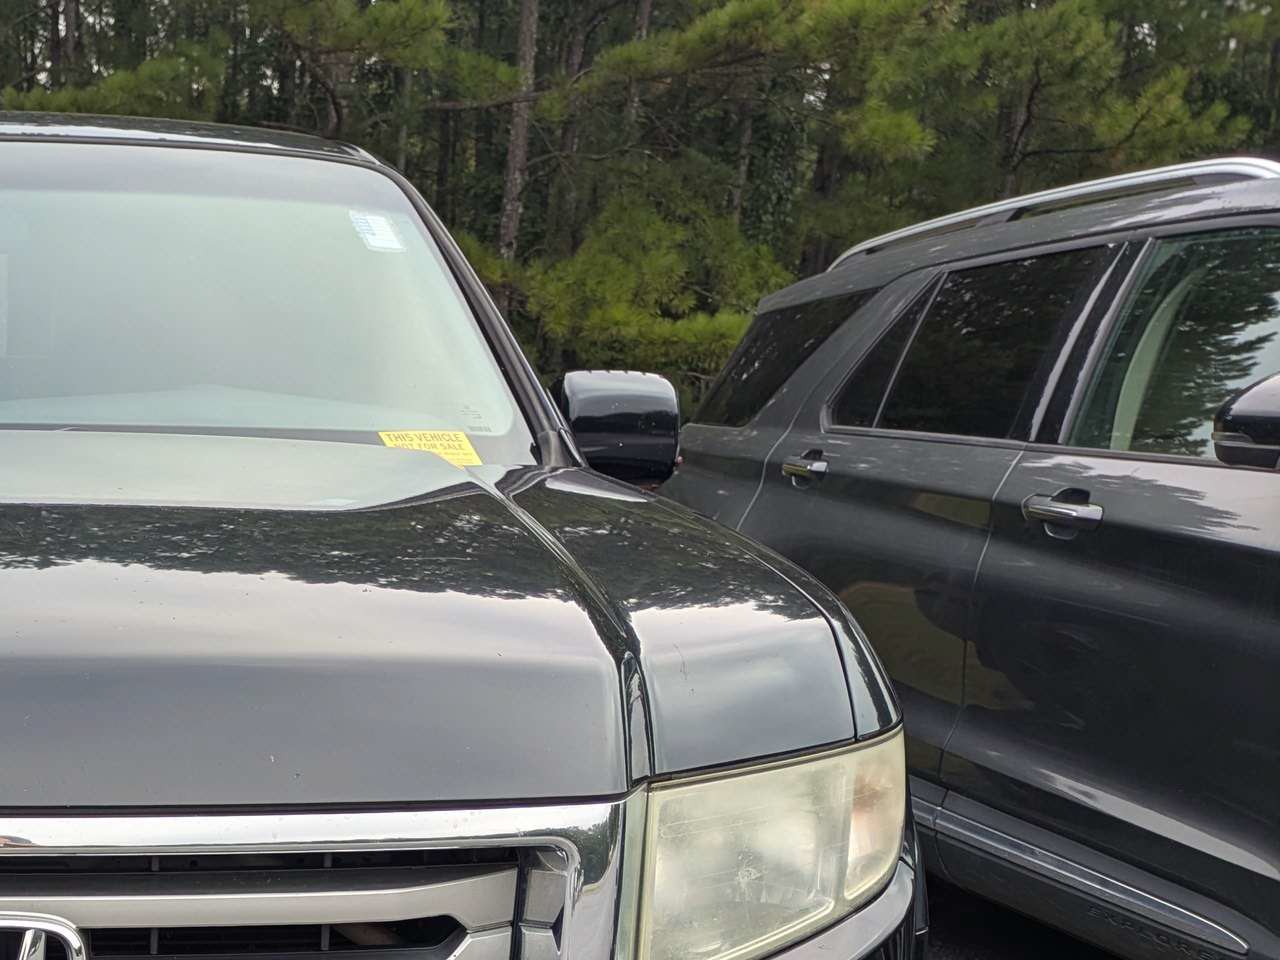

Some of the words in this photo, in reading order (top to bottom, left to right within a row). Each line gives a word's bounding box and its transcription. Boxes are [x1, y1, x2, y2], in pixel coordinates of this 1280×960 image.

[384, 433, 414, 442] THIS
[415, 433, 464, 443] VEHICLE
[441, 443, 466, 451] SALE
